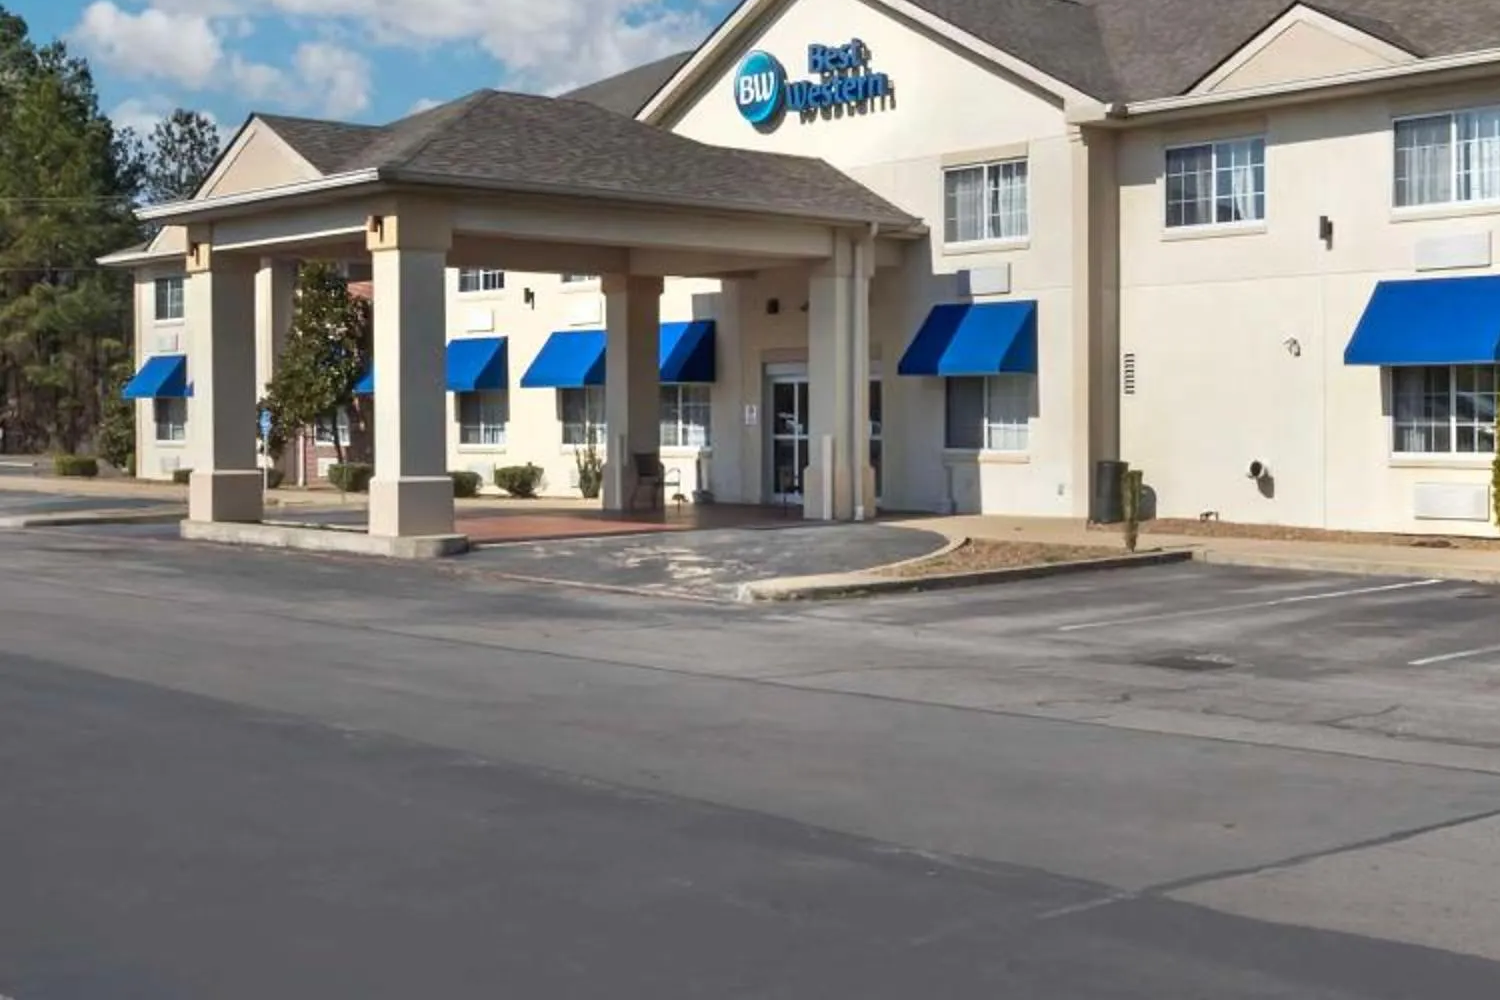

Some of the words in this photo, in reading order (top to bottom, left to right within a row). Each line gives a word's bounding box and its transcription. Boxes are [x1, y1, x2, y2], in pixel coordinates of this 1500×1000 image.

[807, 38, 864, 73] Best
[739, 71, 774, 105] BW
[785, 72, 889, 112] Western
